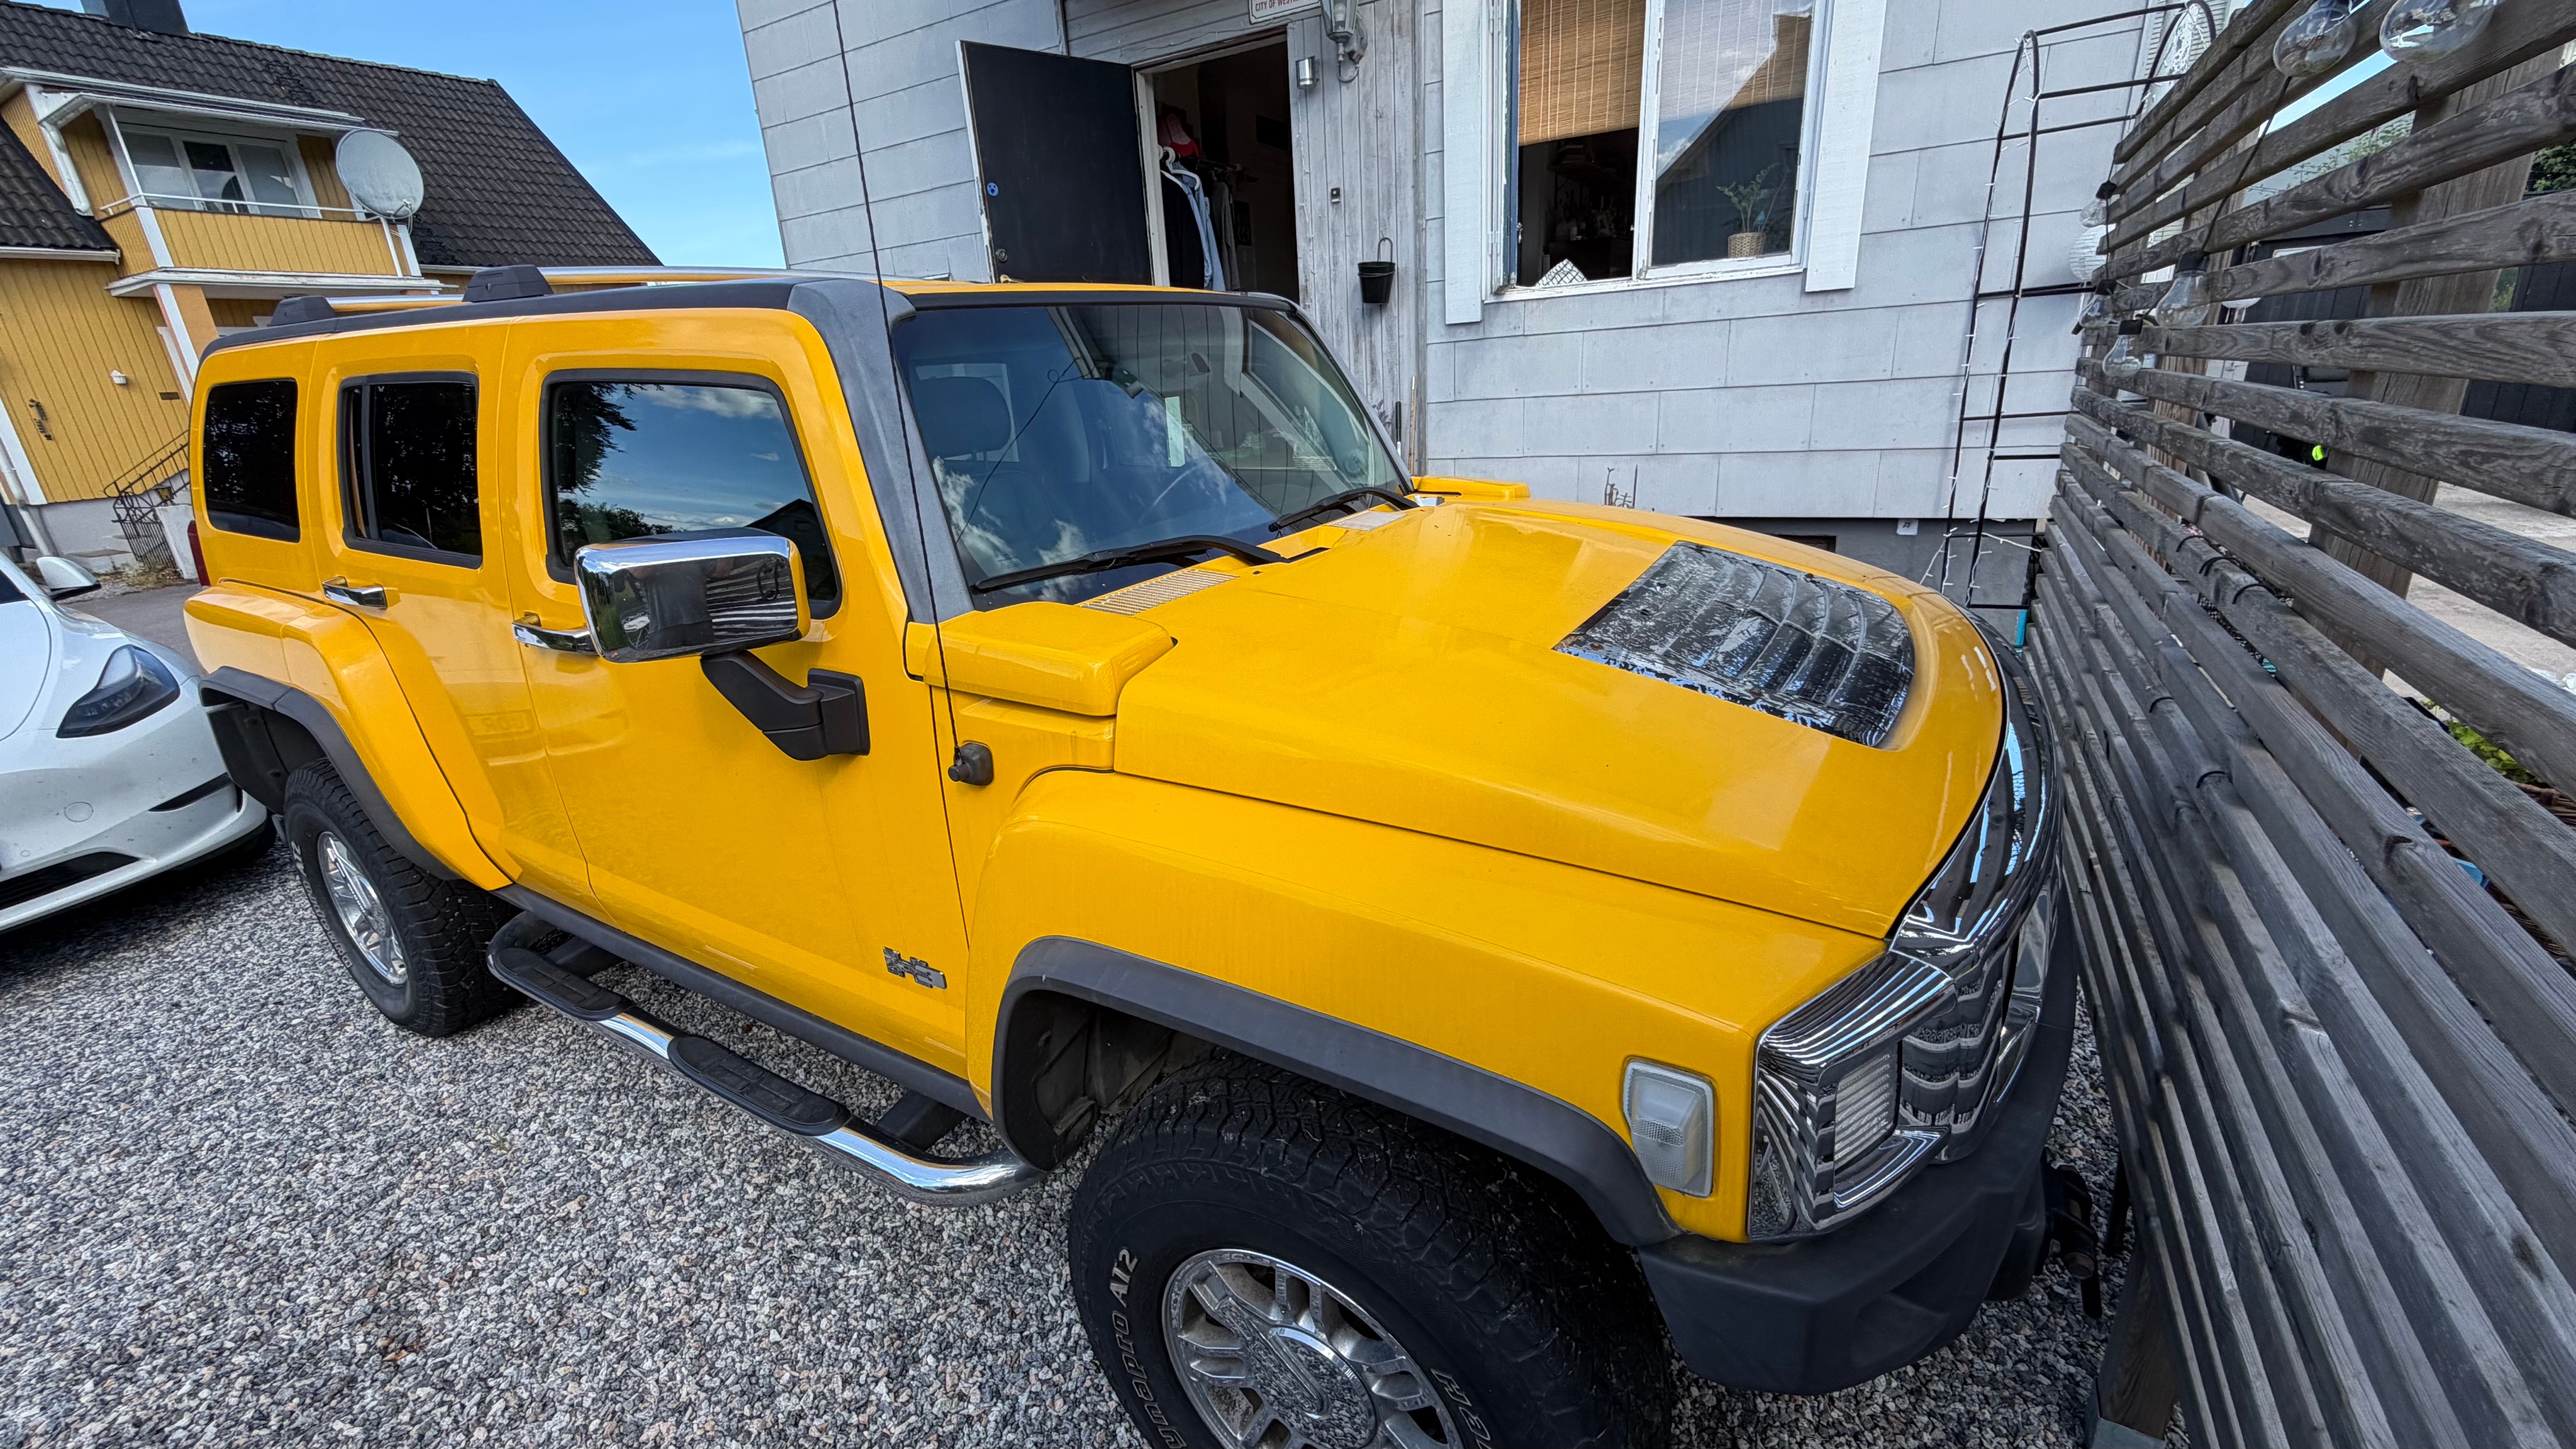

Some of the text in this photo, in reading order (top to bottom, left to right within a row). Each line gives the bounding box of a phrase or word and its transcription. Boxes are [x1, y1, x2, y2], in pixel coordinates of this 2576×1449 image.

[1255, 1, 1267, 12] CITY
[1269, 0, 1276, 8] OF
[1109, 1248, 1139, 1308] AT2
